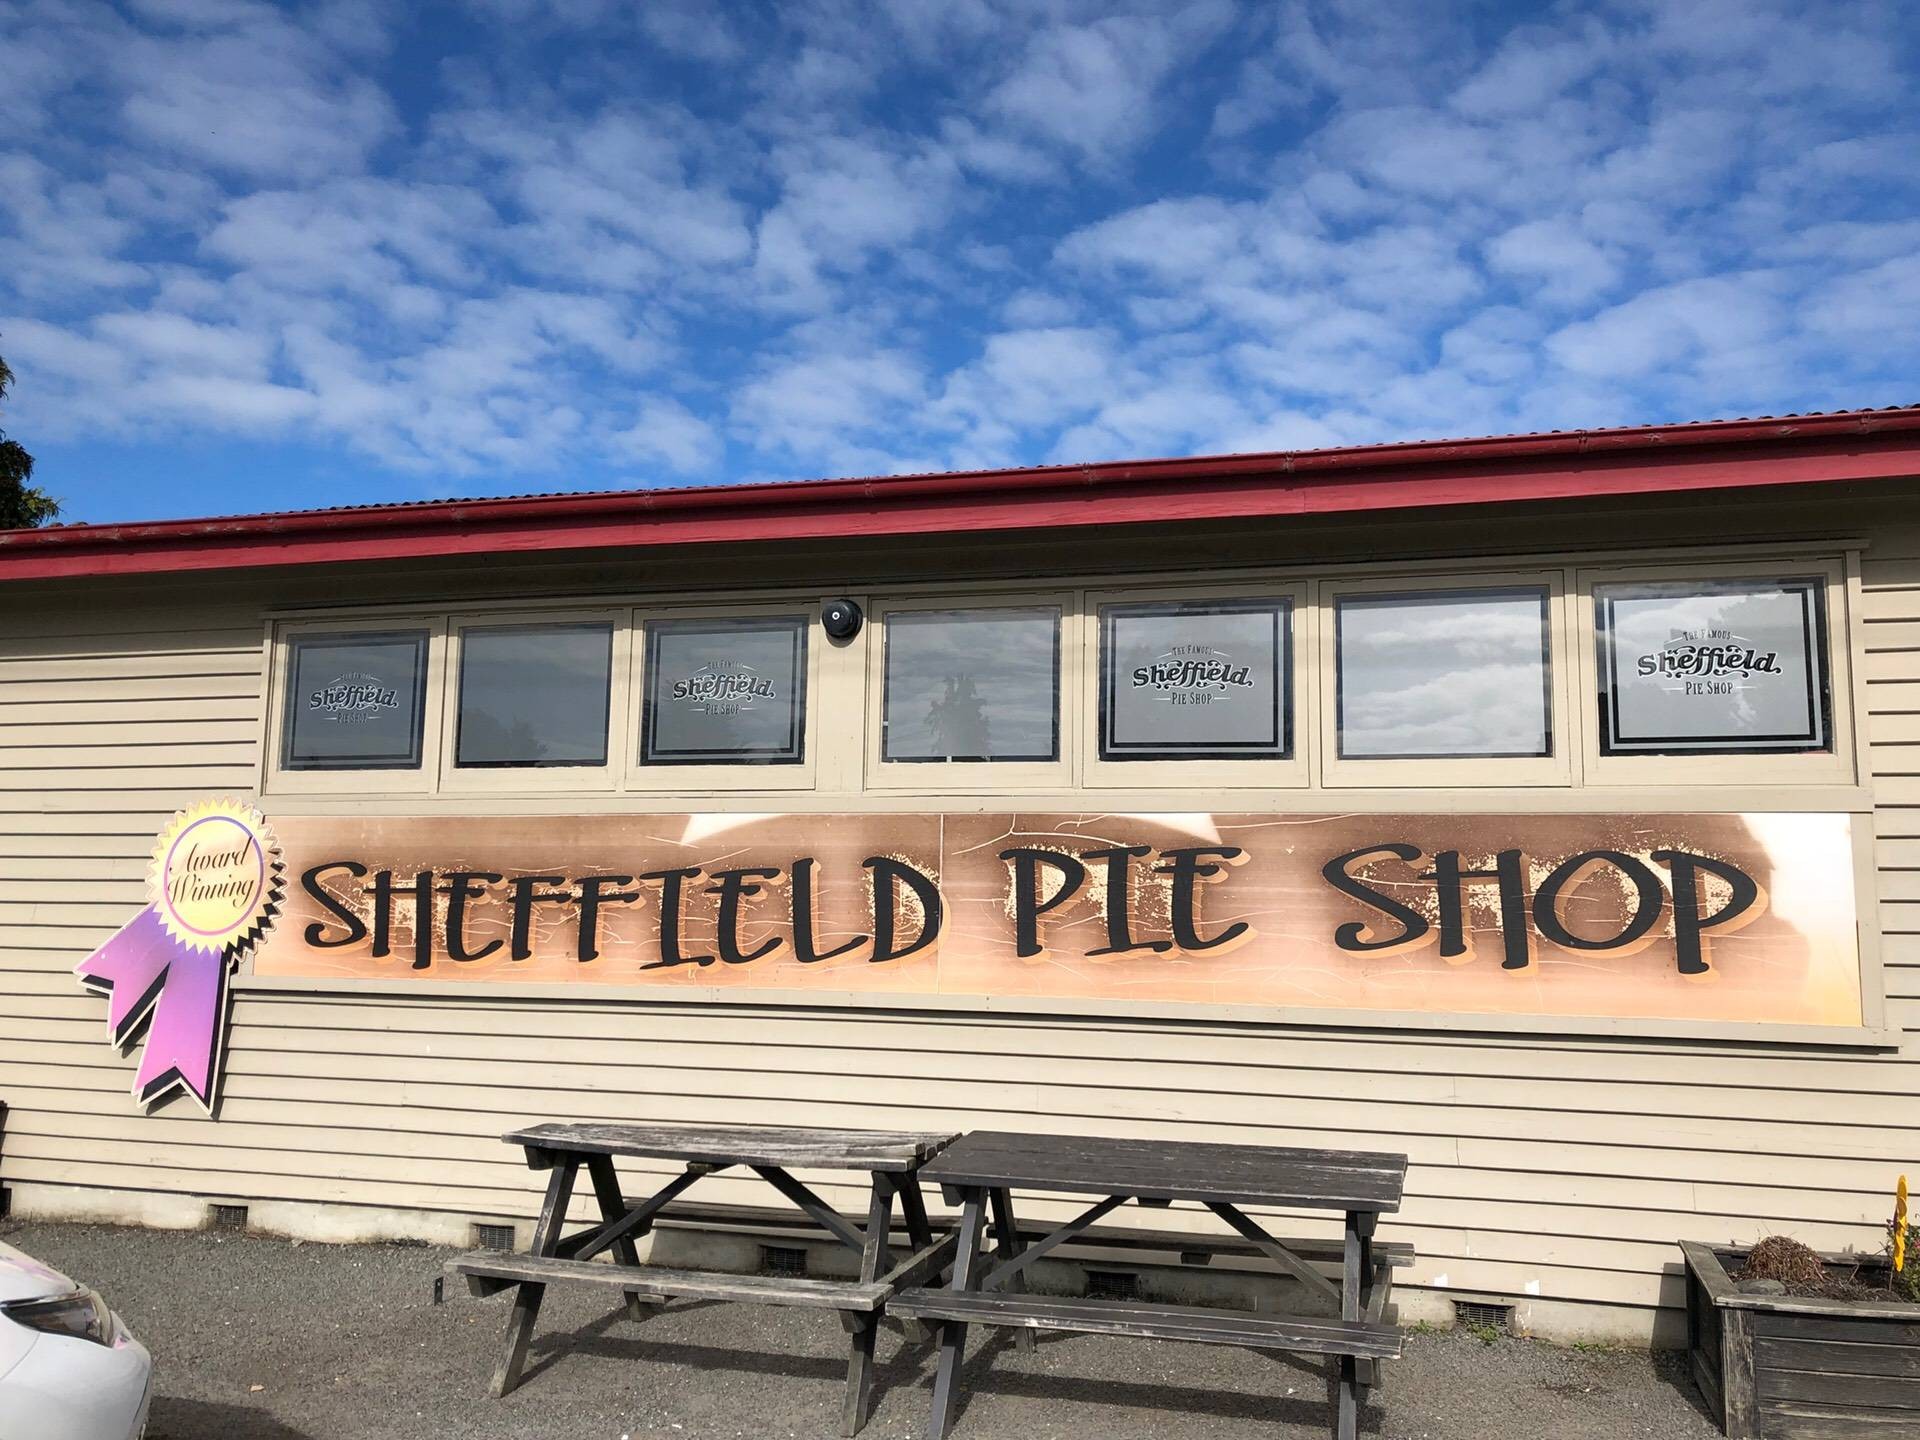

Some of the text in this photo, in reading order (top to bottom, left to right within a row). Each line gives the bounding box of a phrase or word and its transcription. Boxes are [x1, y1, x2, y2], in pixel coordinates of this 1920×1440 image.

[1132, 659, 1254, 691] Sheffield
[1637, 644, 1782, 678] Sheffield
[308, 683, 399, 712] Sheffield
[672, 672, 776, 702] Sheffield
[1171, 692, 1214, 705] PIE SHOP
[1686, 680, 1734, 695] PIE SHOP
[168, 836, 253, 873] Award
[167, 873, 254, 908] Winning
[300, 842, 1760, 975] SHEFFIELD PIE SHOP
